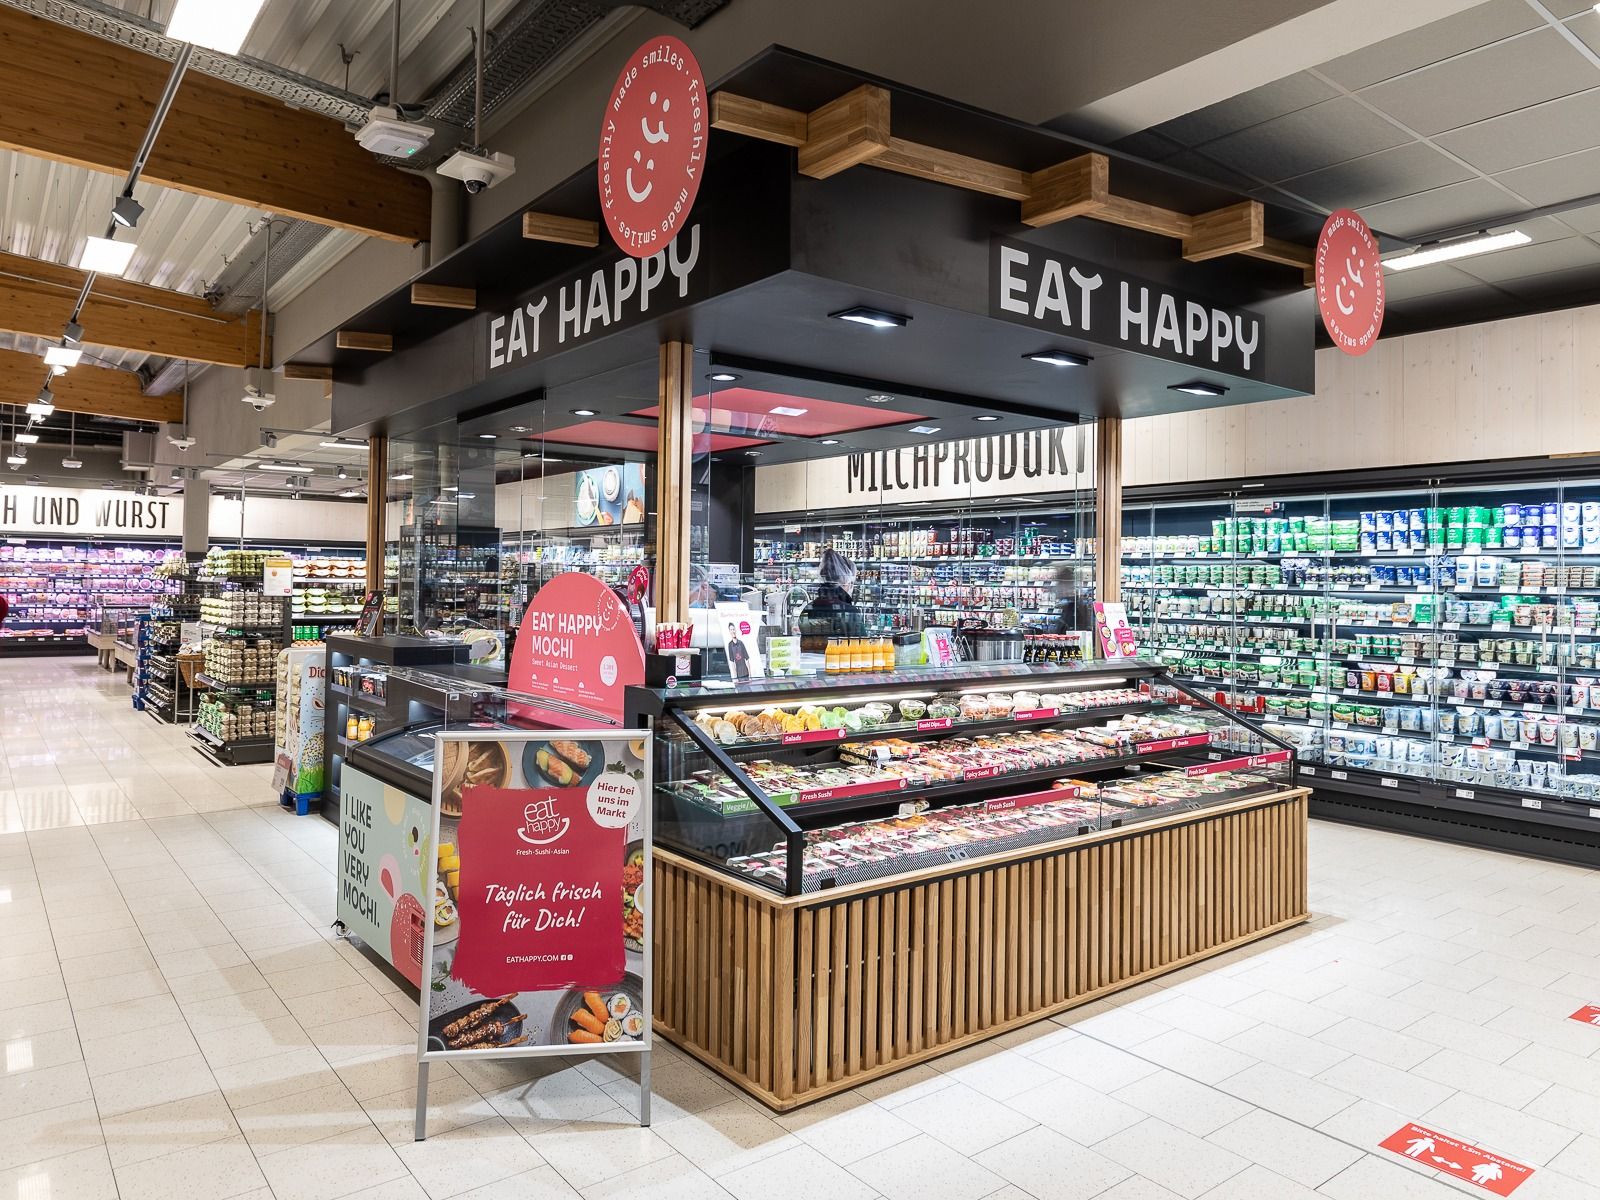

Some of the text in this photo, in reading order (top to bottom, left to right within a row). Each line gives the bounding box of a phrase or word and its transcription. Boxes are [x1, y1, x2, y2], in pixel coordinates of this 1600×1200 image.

[602, 45, 684, 209] freshly made smiles
[618, 78, 702, 248] freshly made smiles
[1327, 216, 1345, 237] made
[1347, 216, 1372, 249] smiles
[490, 223, 700, 369] EAT HAPPY
[1001, 245, 1259, 370] EAT HAPPY
[1330, 318, 1357, 347] smiles
[1359, 324, 1375, 347] made
[33, 495, 79, 526] UND
[95, 499, 170, 529] WURST
[532, 612, 602, 637] EAT HAPPY
[532, 635, 573, 659] MOCHI
[532, 658, 545, 667] Sweet
[560, 662, 578, 672] Dessert
[597, 782, 635, 795] Hier bei
[598, 796, 629, 807] uns im
[802, 790, 832, 800] Fresh Sushi
[351, 796, 372, 829] LIKE
[524, 795, 560, 822] eat
[596, 806, 626, 819] Markt
[988, 800, 1016, 811] Fresh Sushi
[344, 821, 366, 854] YOU
[525, 816, 561, 835] happy
[343, 850, 370, 888] VERY
[343, 879, 380, 929] MOCHI.
[485, 881, 602, 907] Täglich frisch
[502, 906, 586, 933] für Dich!
[506, 954, 559, 964] EATHAPPY.COM
[1411, 1126, 1432, 1137] Bitte
[1482, 1153, 1527, 1173] Abstand!
